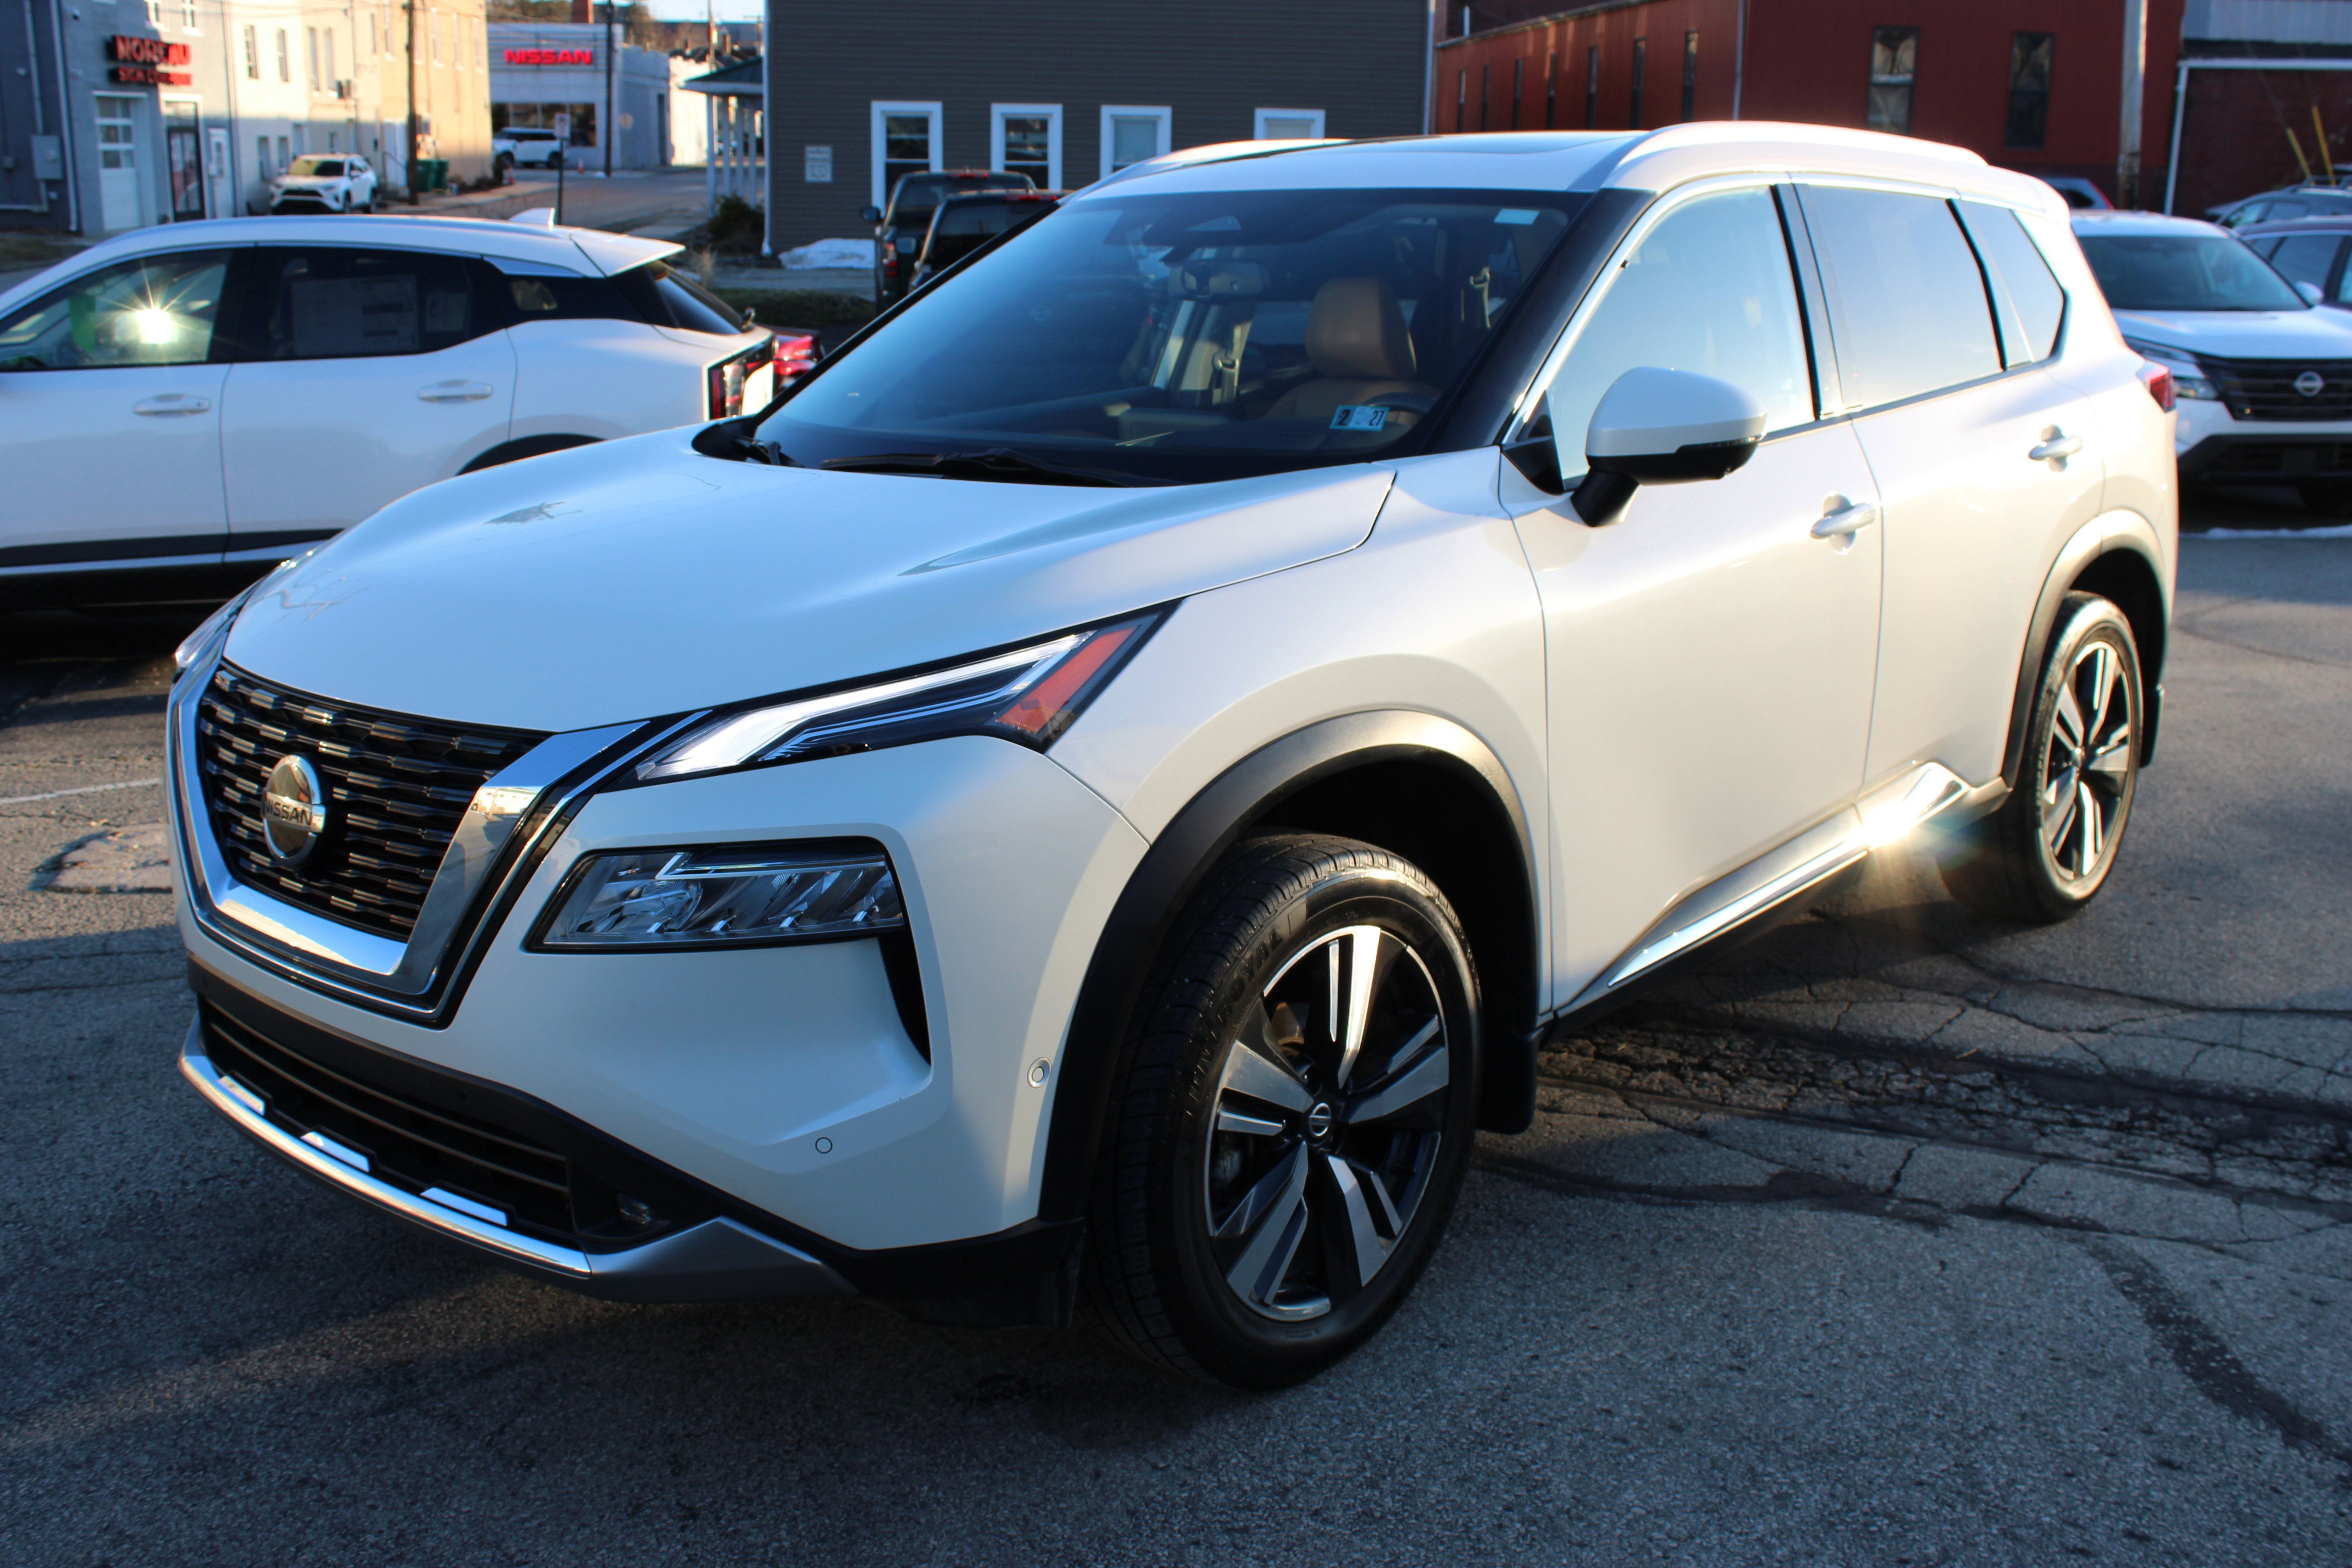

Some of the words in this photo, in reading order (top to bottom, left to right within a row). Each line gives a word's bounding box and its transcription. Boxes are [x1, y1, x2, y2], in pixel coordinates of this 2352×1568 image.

[504, 49, 592, 64] NISSAN
[1338, 409, 1350, 426] 2
[1370, 410, 1385, 427] 27
[266, 799, 312, 826] NISSAN
[1189, 928, 1282, 1102] UNIROYAL
